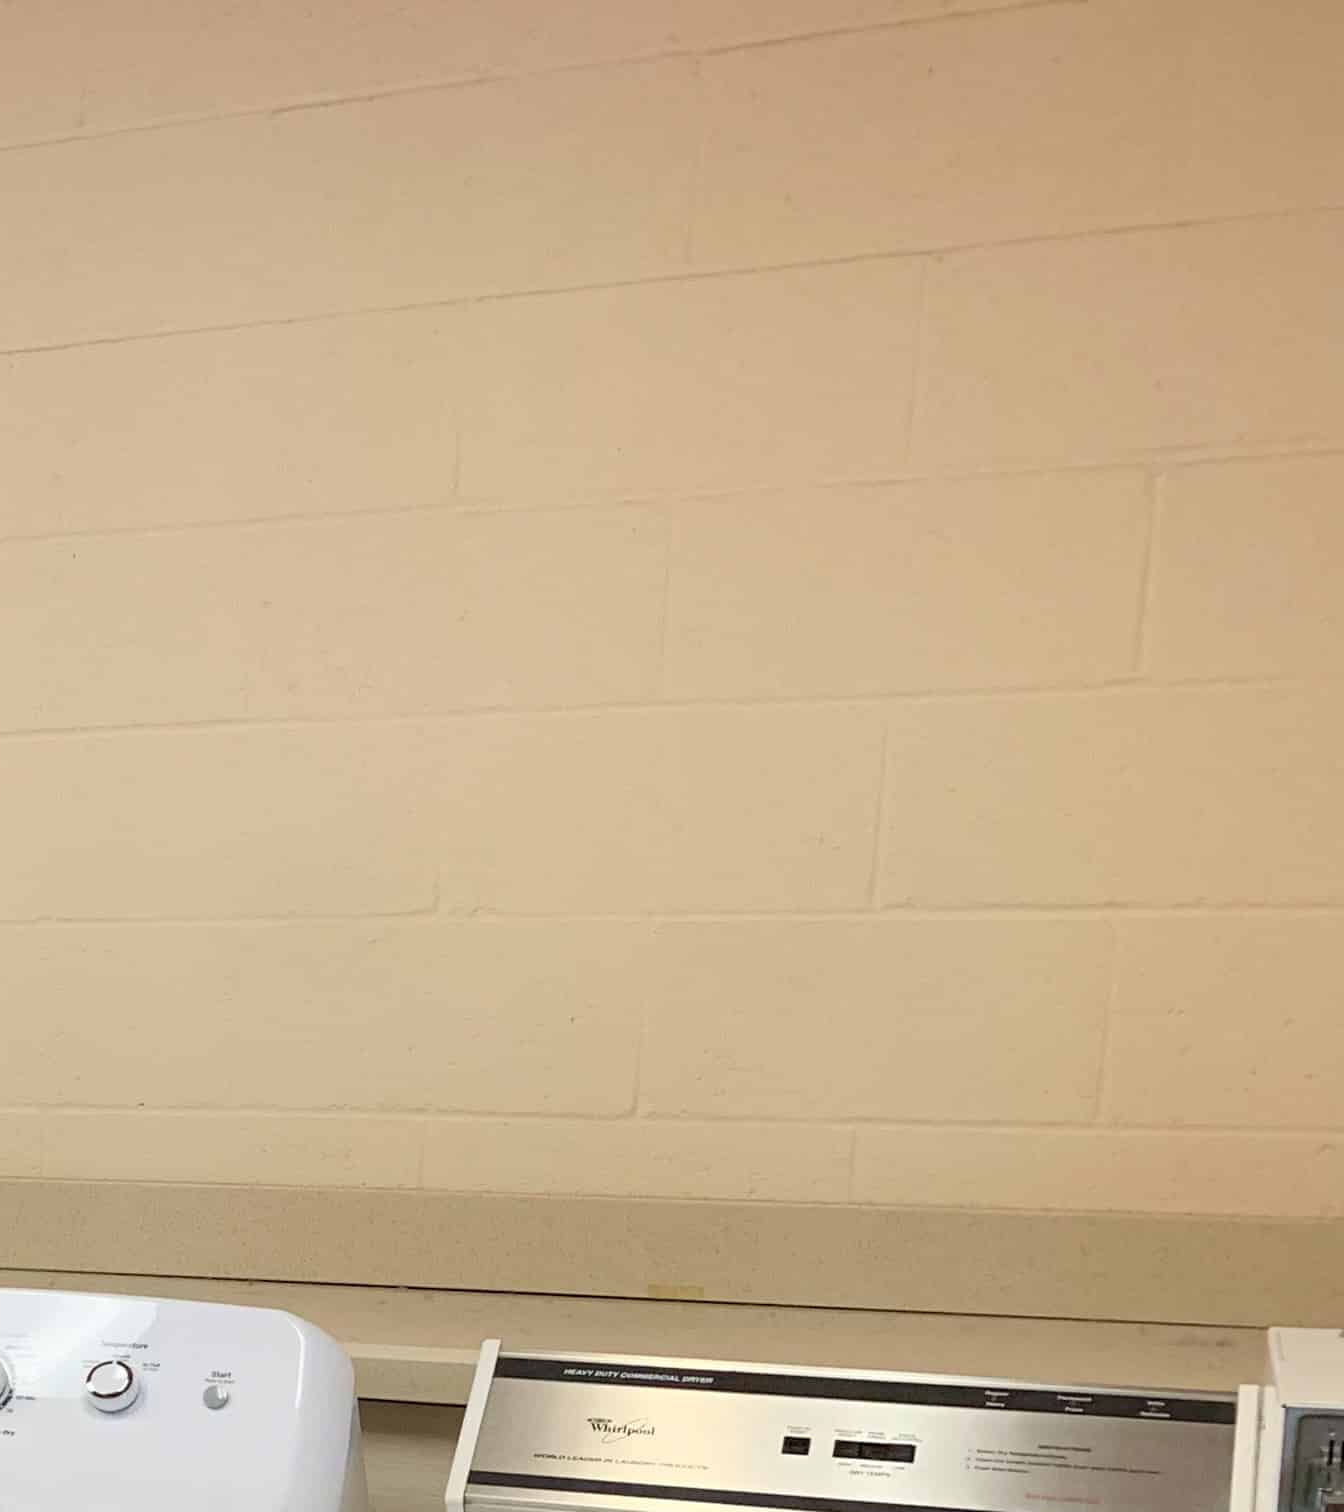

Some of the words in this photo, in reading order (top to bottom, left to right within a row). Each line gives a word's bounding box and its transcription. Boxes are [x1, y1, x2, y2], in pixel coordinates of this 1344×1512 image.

[563, 1368, 594, 1376] HEAVY
[594, 1370, 619, 1378] DUTY
[620, 1372, 680, 1382] COMMERCIAL
[590, 1423, 656, 1436] Whirlpool
